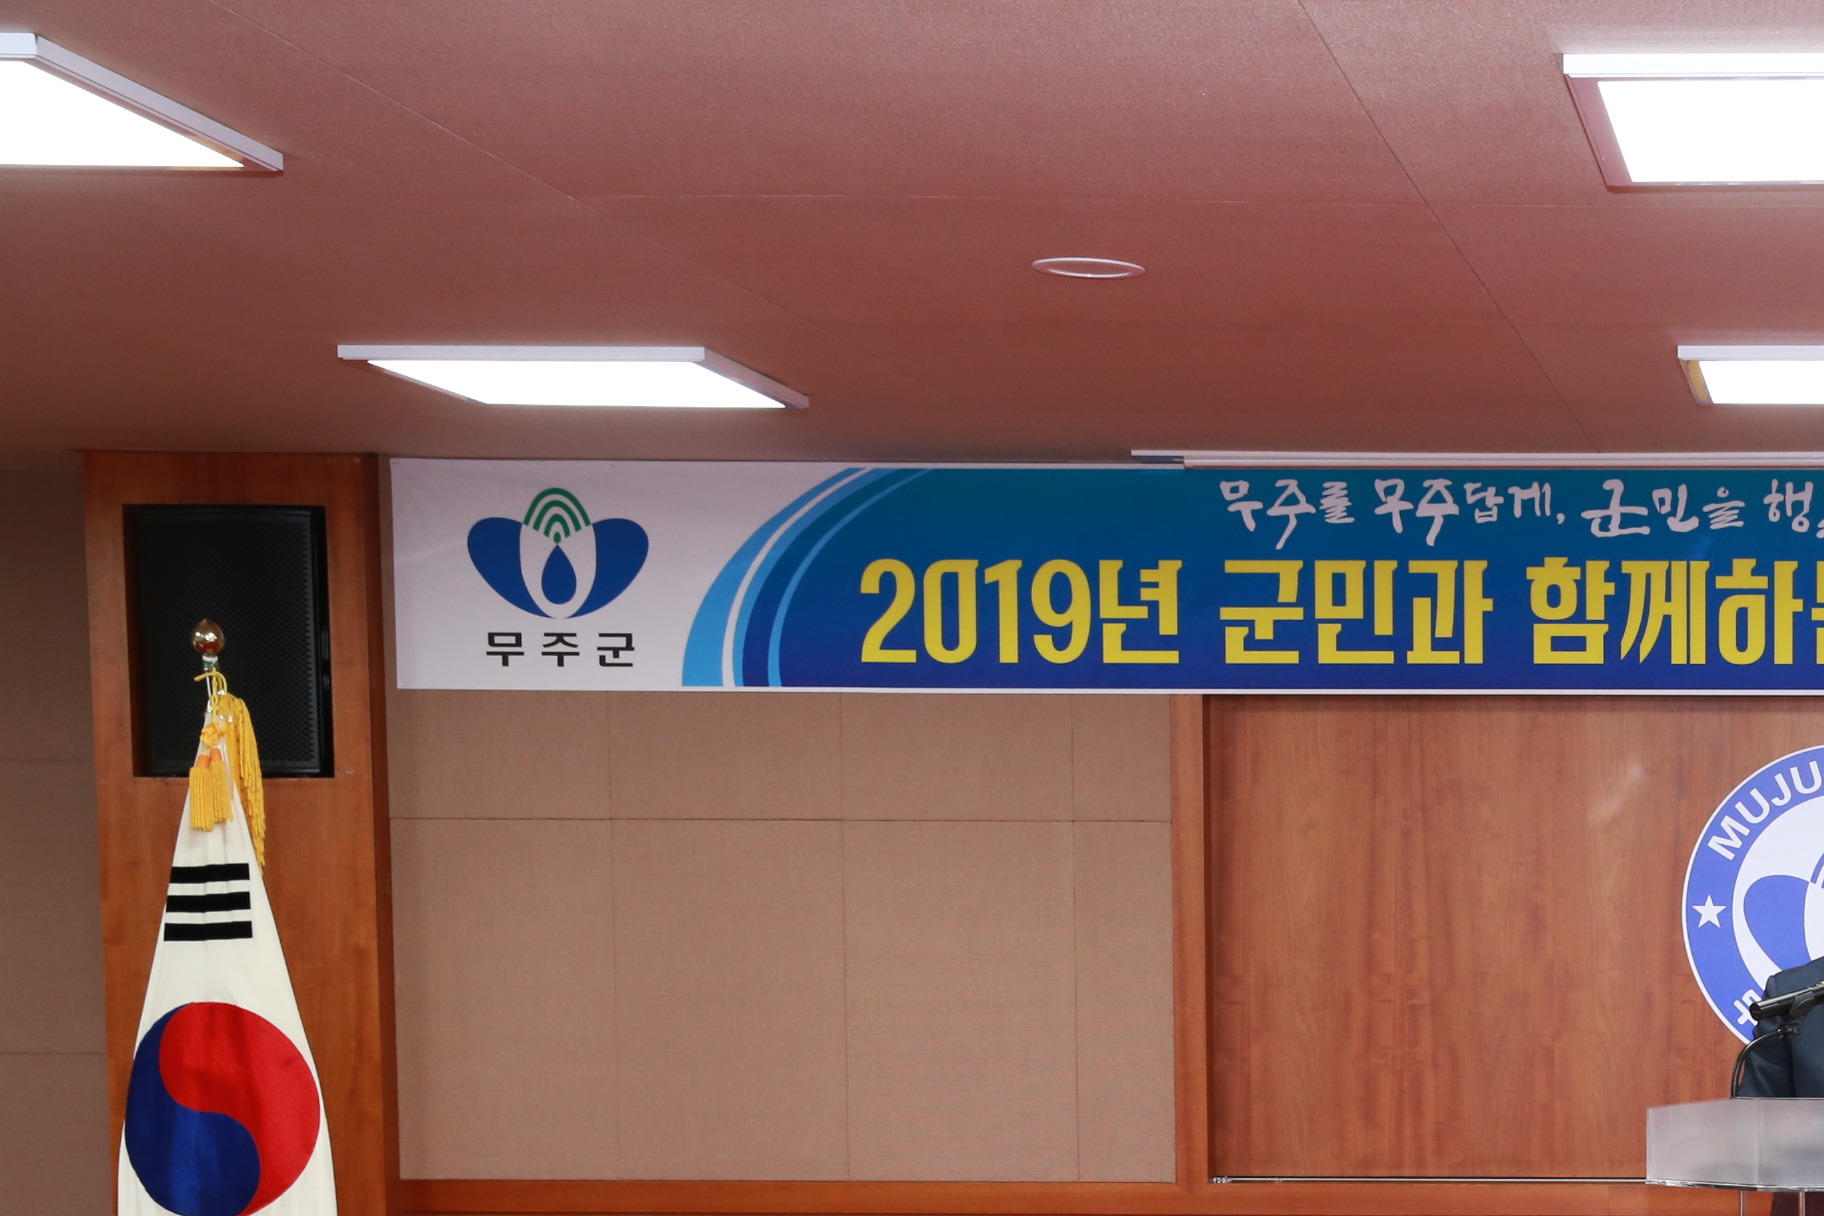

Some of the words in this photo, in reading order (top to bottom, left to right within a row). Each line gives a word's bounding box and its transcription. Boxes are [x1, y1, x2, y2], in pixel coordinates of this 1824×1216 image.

[1219, 479, 1355, 550] 무주를
[1581, 479, 1746, 538] 군민을
[860, 559, 1182, 664] 2019년
[1220, 560, 1493, 664] 군민과
[1707, 760, 1823, 861] MUJU
